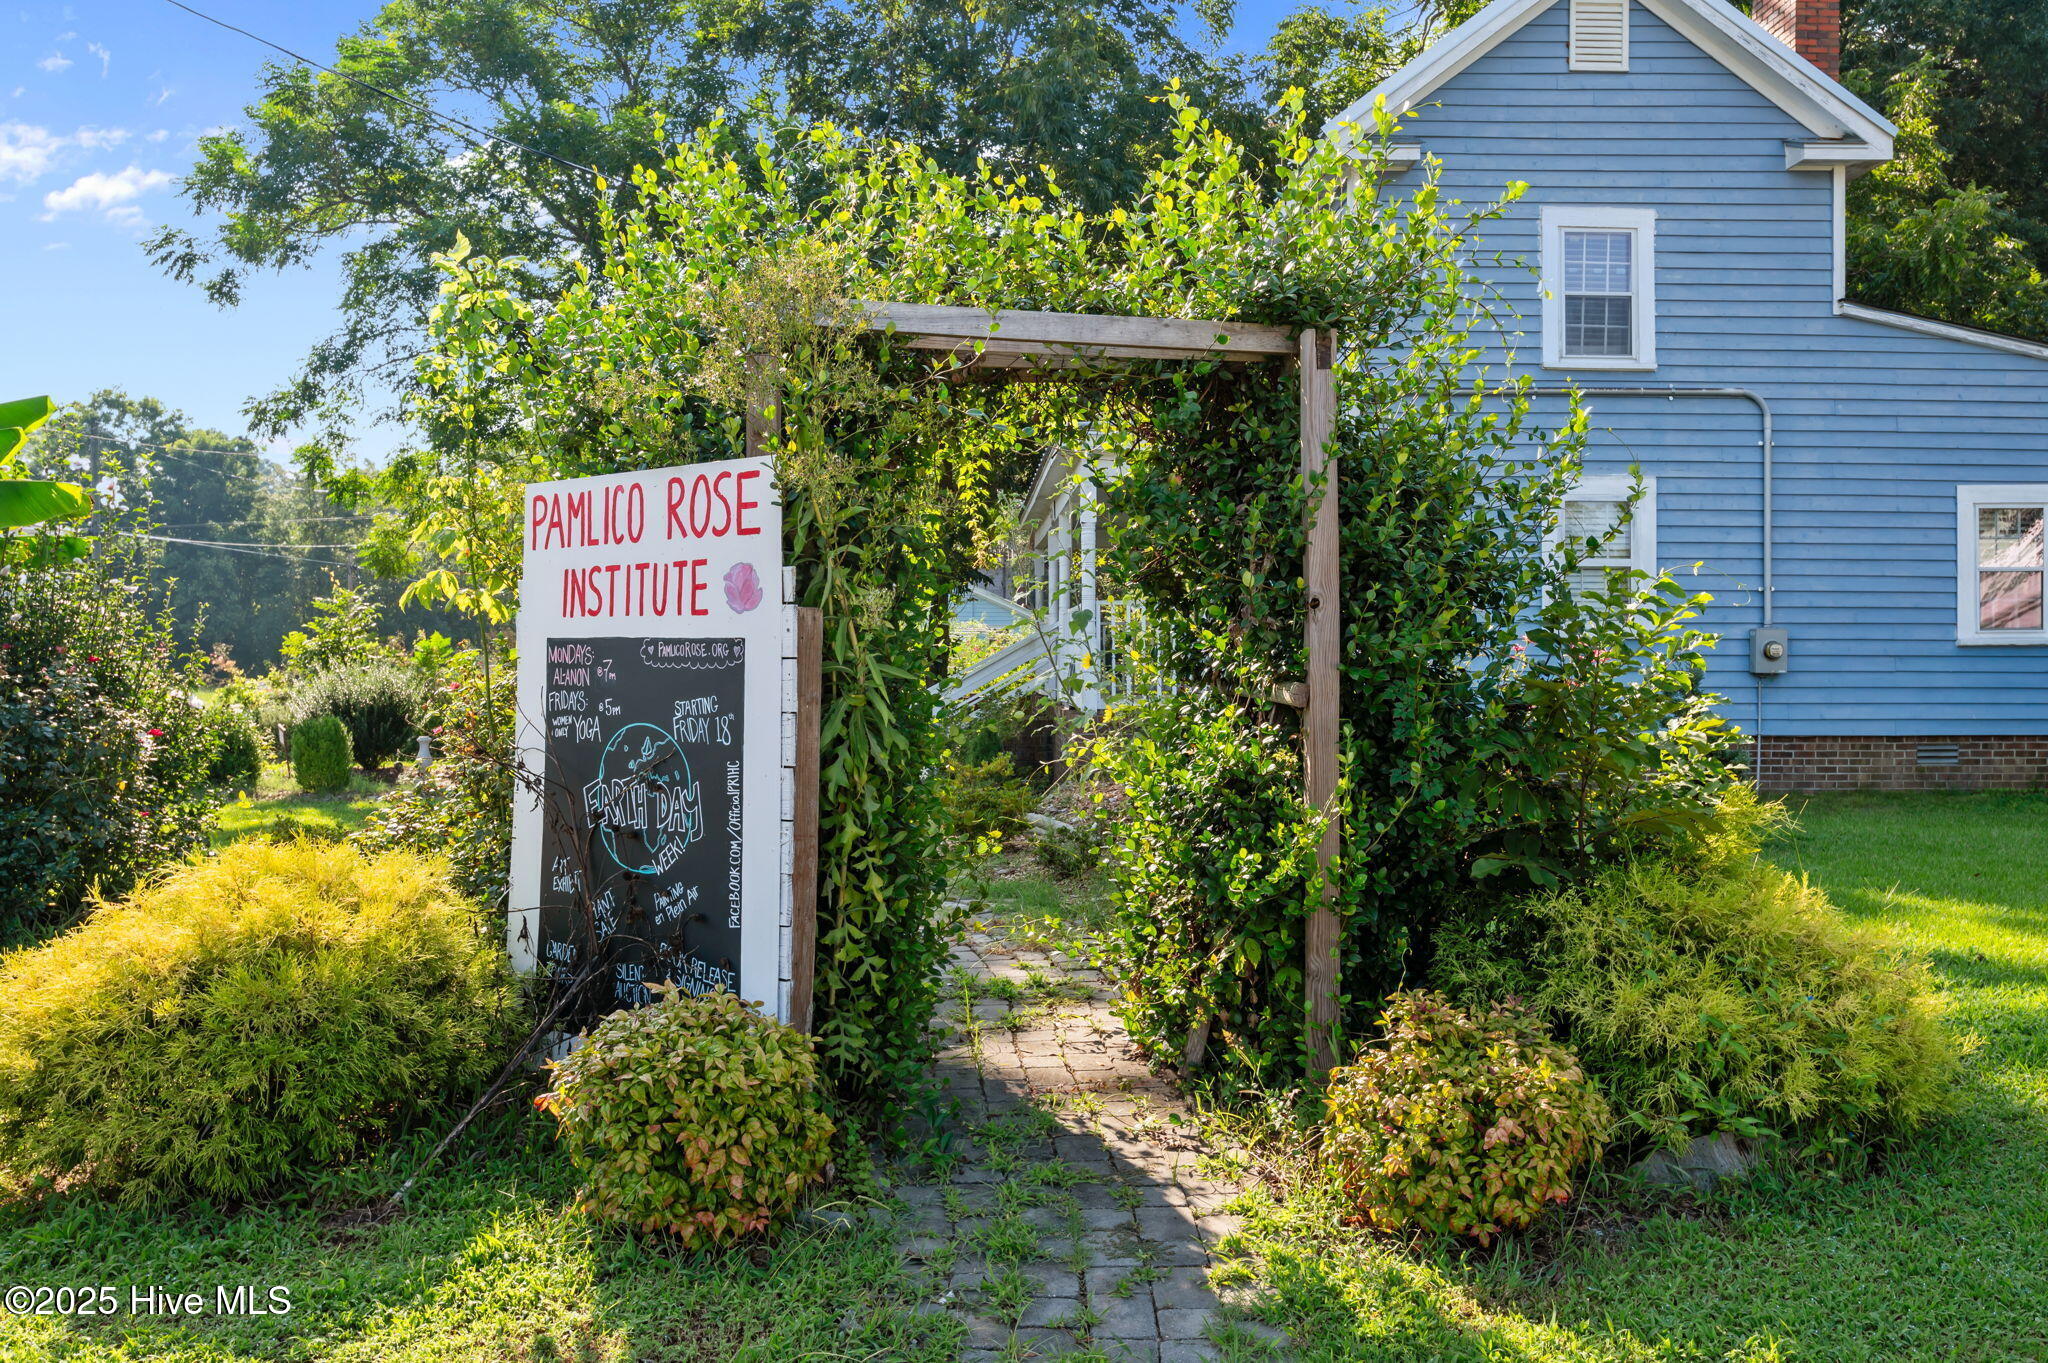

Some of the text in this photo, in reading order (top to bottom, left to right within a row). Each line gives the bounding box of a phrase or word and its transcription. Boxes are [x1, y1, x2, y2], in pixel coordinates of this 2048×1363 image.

[532, 470, 761, 550] PAMLICO ROSE
[562, 558, 709, 618] INSTITUTE
[674, 695, 719, 716] STARTING
[573, 714, 602, 743] YOGA
[672, 715, 710, 745] FRIDAY
[583, 778, 704, 843] EARTH DAY
[651, 836, 686, 876] WEEK!
